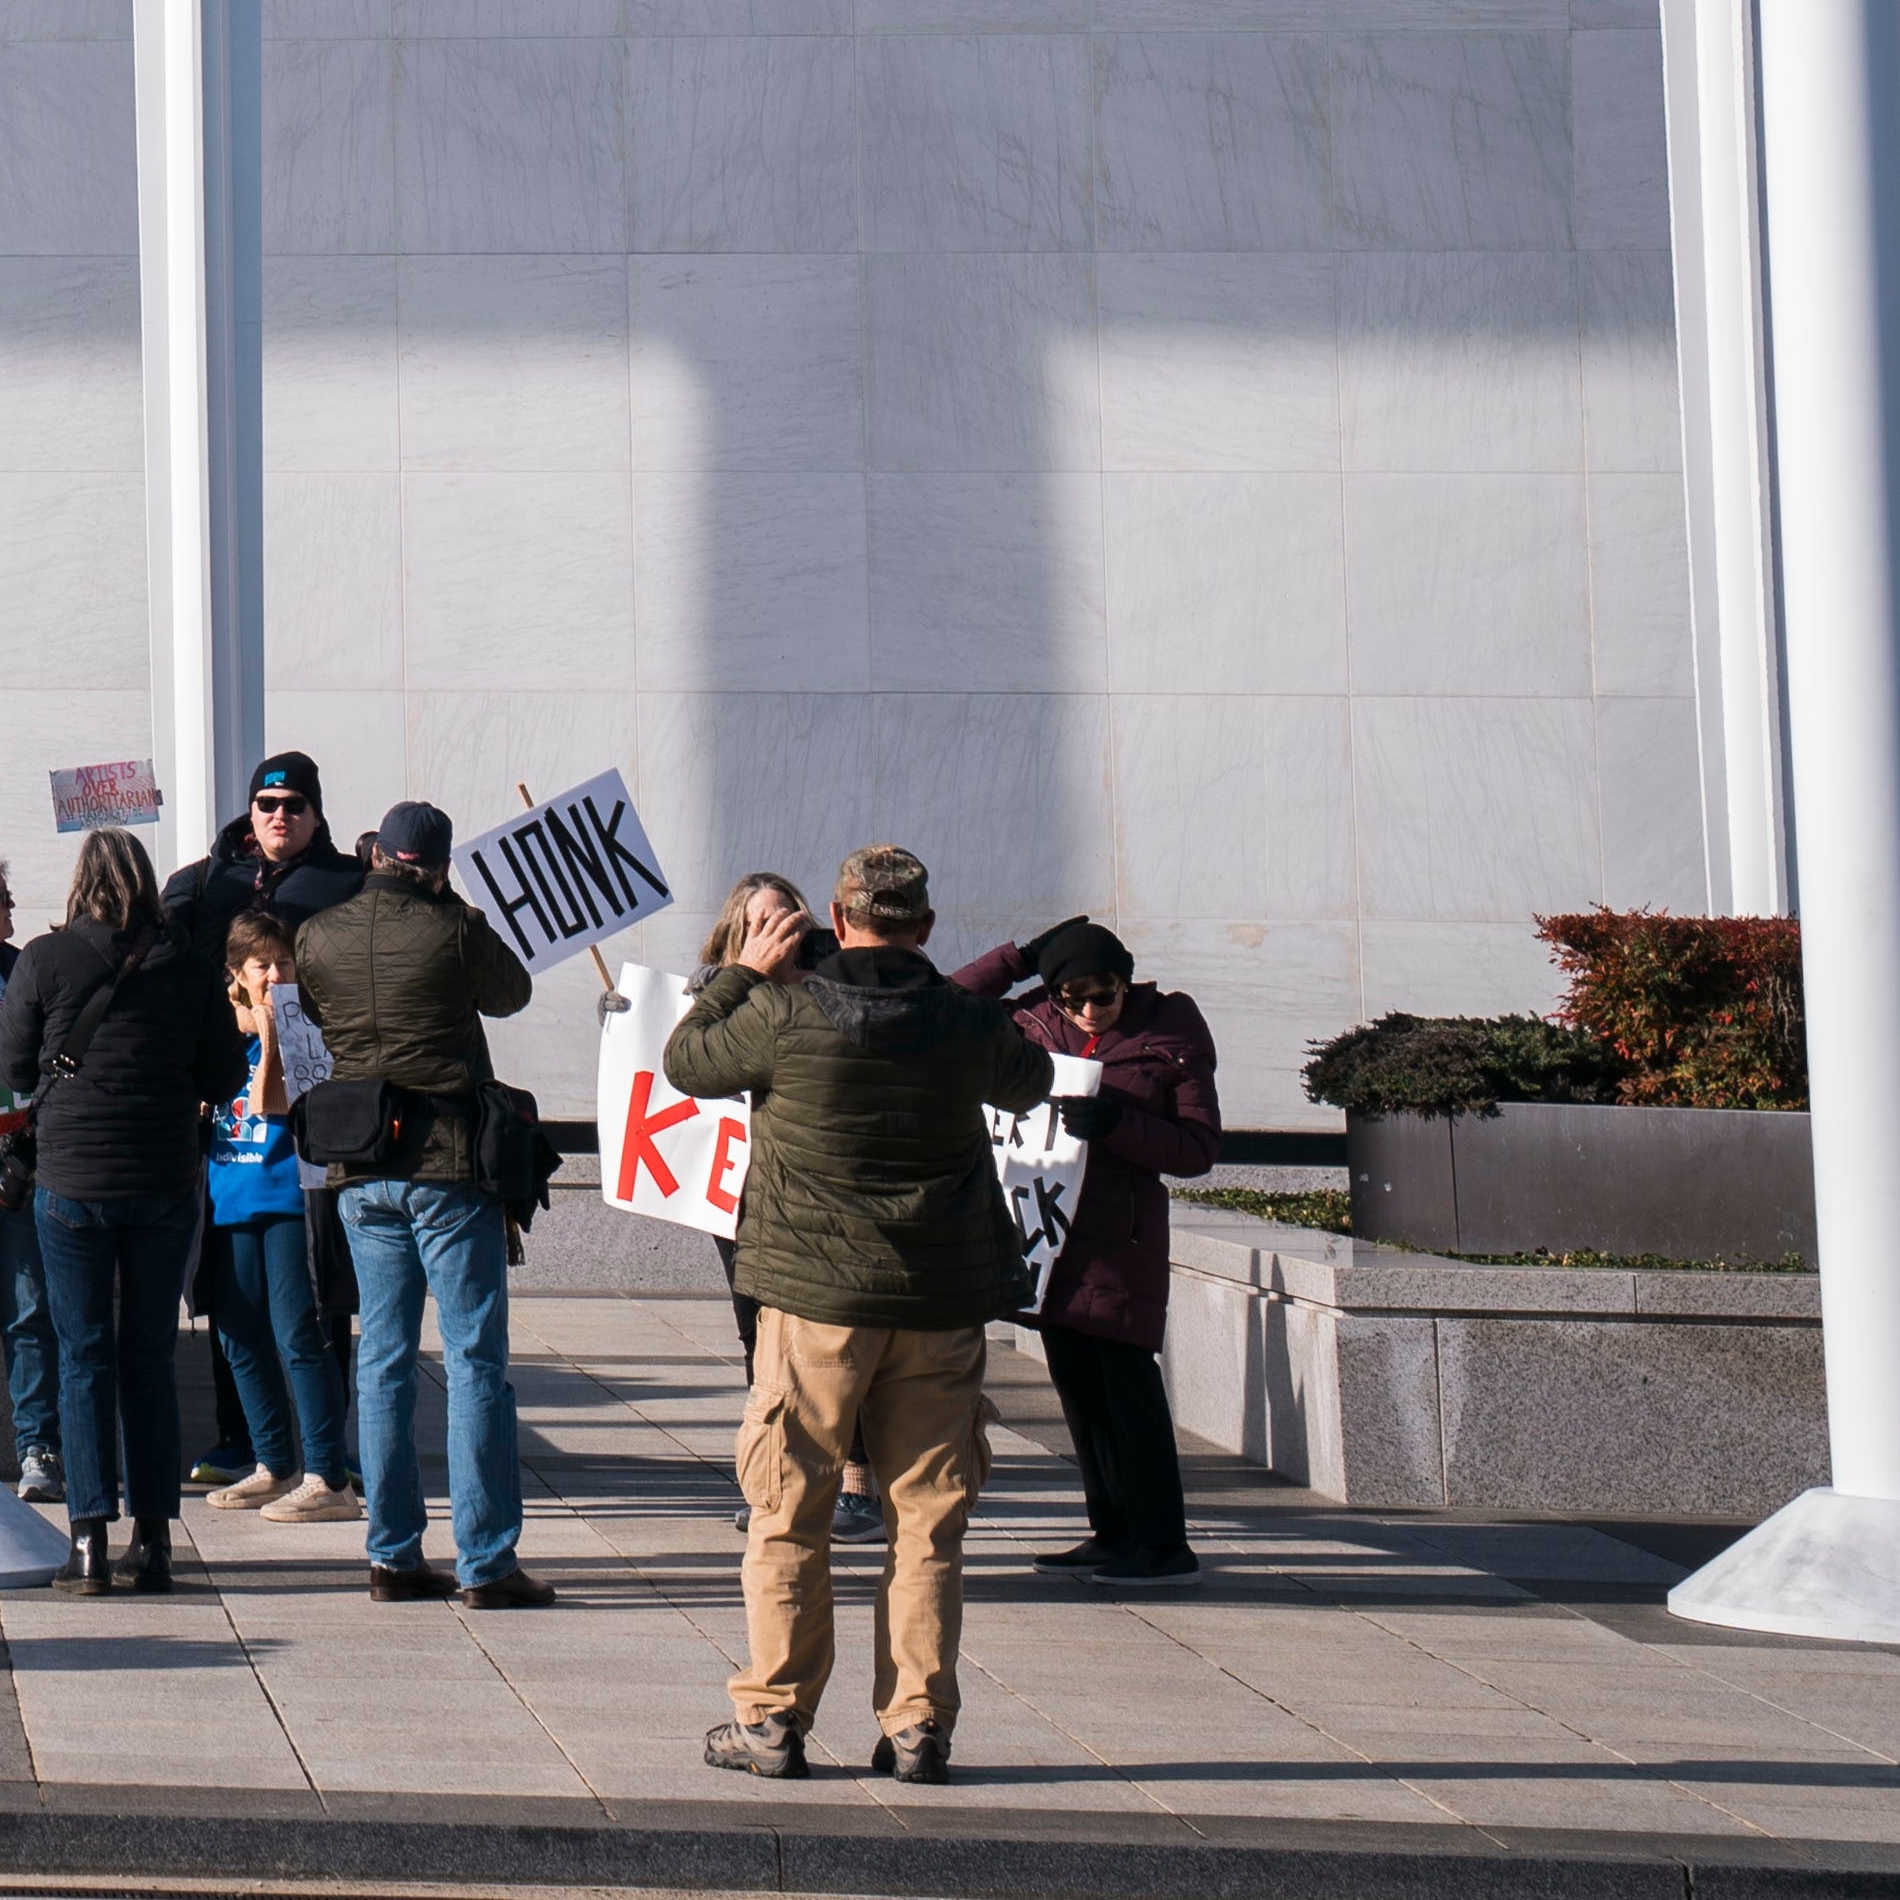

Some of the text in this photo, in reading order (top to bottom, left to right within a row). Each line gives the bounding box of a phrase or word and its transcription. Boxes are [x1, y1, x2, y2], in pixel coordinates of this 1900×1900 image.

[75, 760, 137, 785] ARTISTS
[82, 778, 119, 798] OVER
[470, 796, 670, 961] HONK
